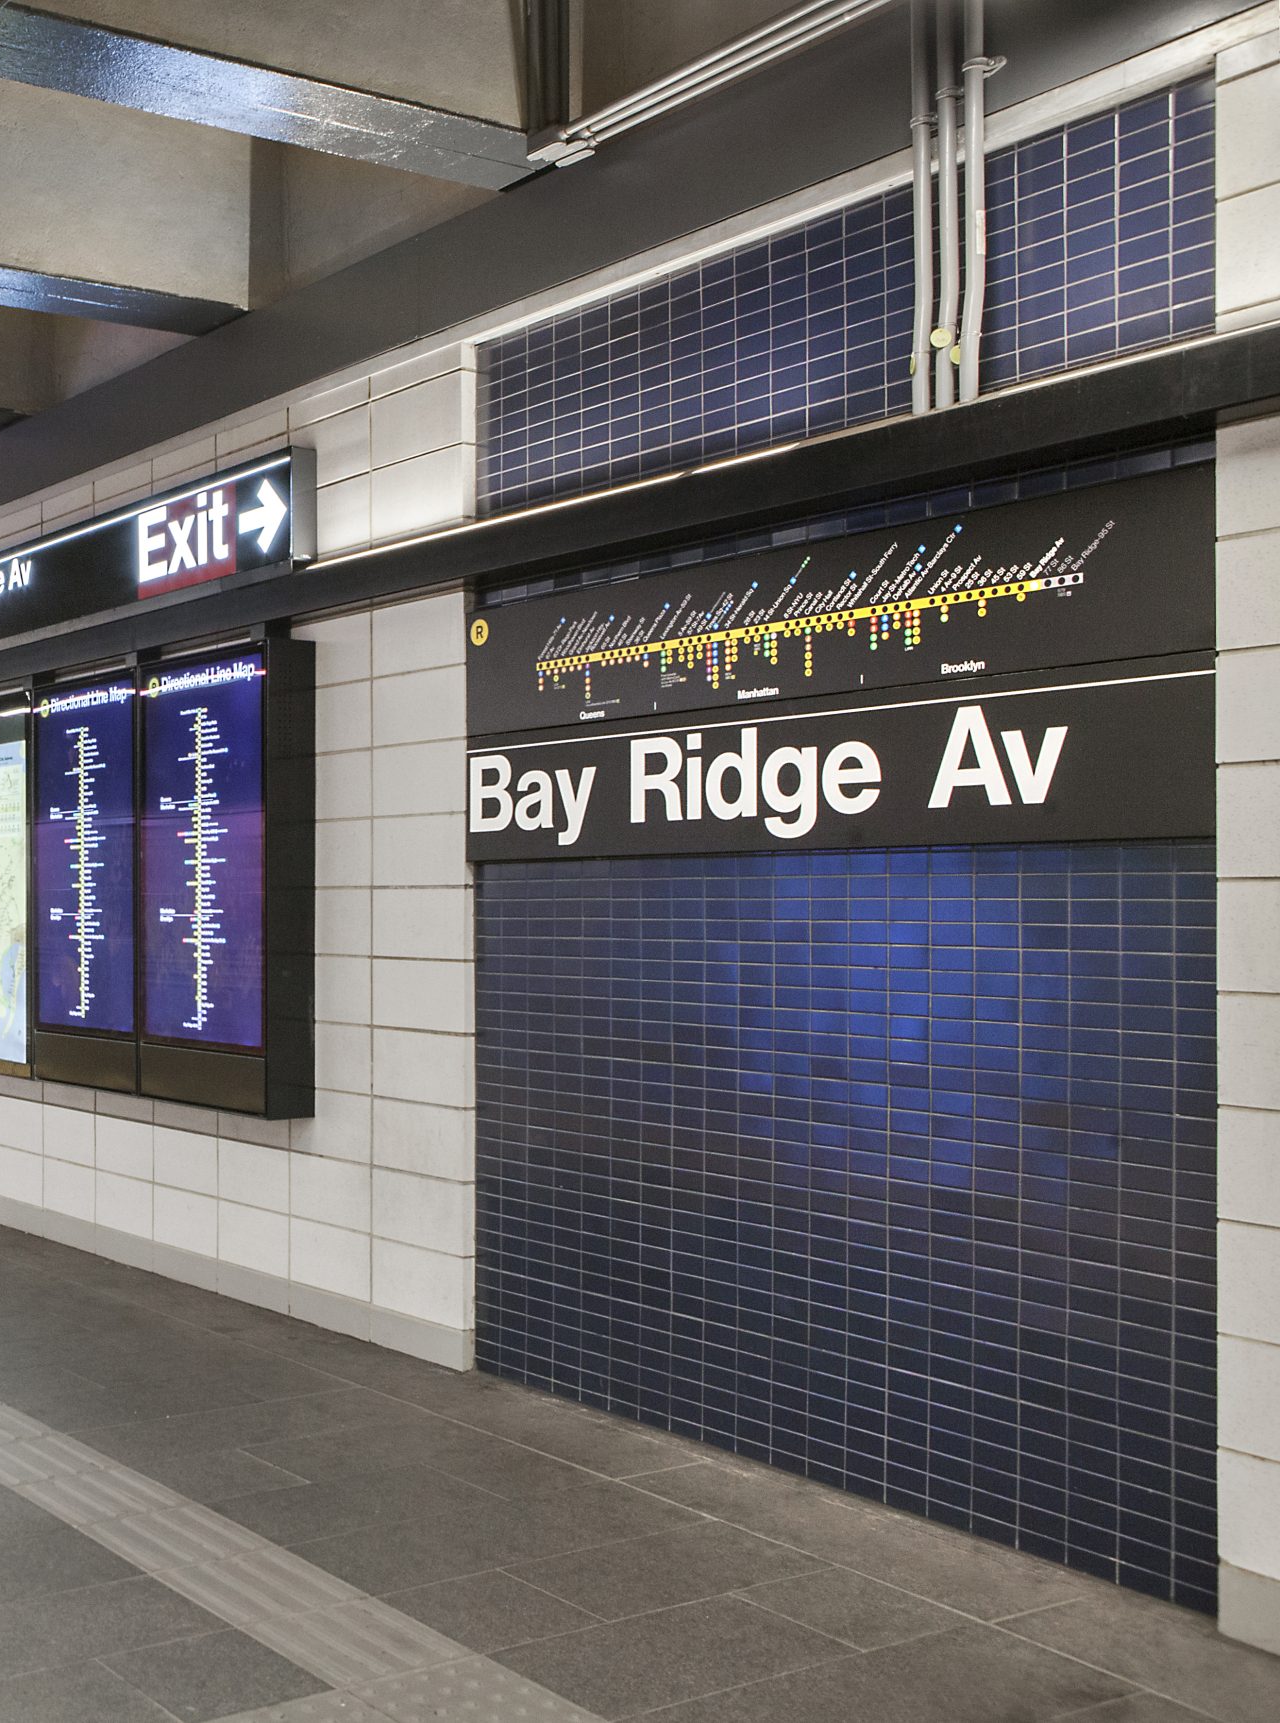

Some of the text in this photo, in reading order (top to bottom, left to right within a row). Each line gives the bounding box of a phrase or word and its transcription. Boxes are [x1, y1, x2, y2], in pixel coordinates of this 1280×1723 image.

[138, 490, 228, 582] Exit
[1071, 557, 1084, 571] Bay
[1106, 520, 1116, 530] St
[1029, 537, 1064, 578] Bay Ridge Av
[1064, 555, 1074, 564] St
[8, 558, 32, 590] Av
[952, 554, 982, 591] Prospect Av
[954, 565, 963, 574] St
[984, 568, 993, 578] St
[996, 566, 1006, 576] St
[1010, 564, 1020, 574] St
[1023, 562, 1032, 572] St
[1043, 558, 1059, 576] 77 St
[928, 569, 949, 594] Union St
[971, 571, 980, 580] St
[941, 660, 985, 674] Brooklyn
[161, 662, 254, 692] Directional Line Map
[51, 686, 126, 713] Directional Line Map
[738, 687, 779, 699] Manhattan
[580, 710, 605, 720] Queens
[469, 705, 1068, 845] Bay Ridge Av
